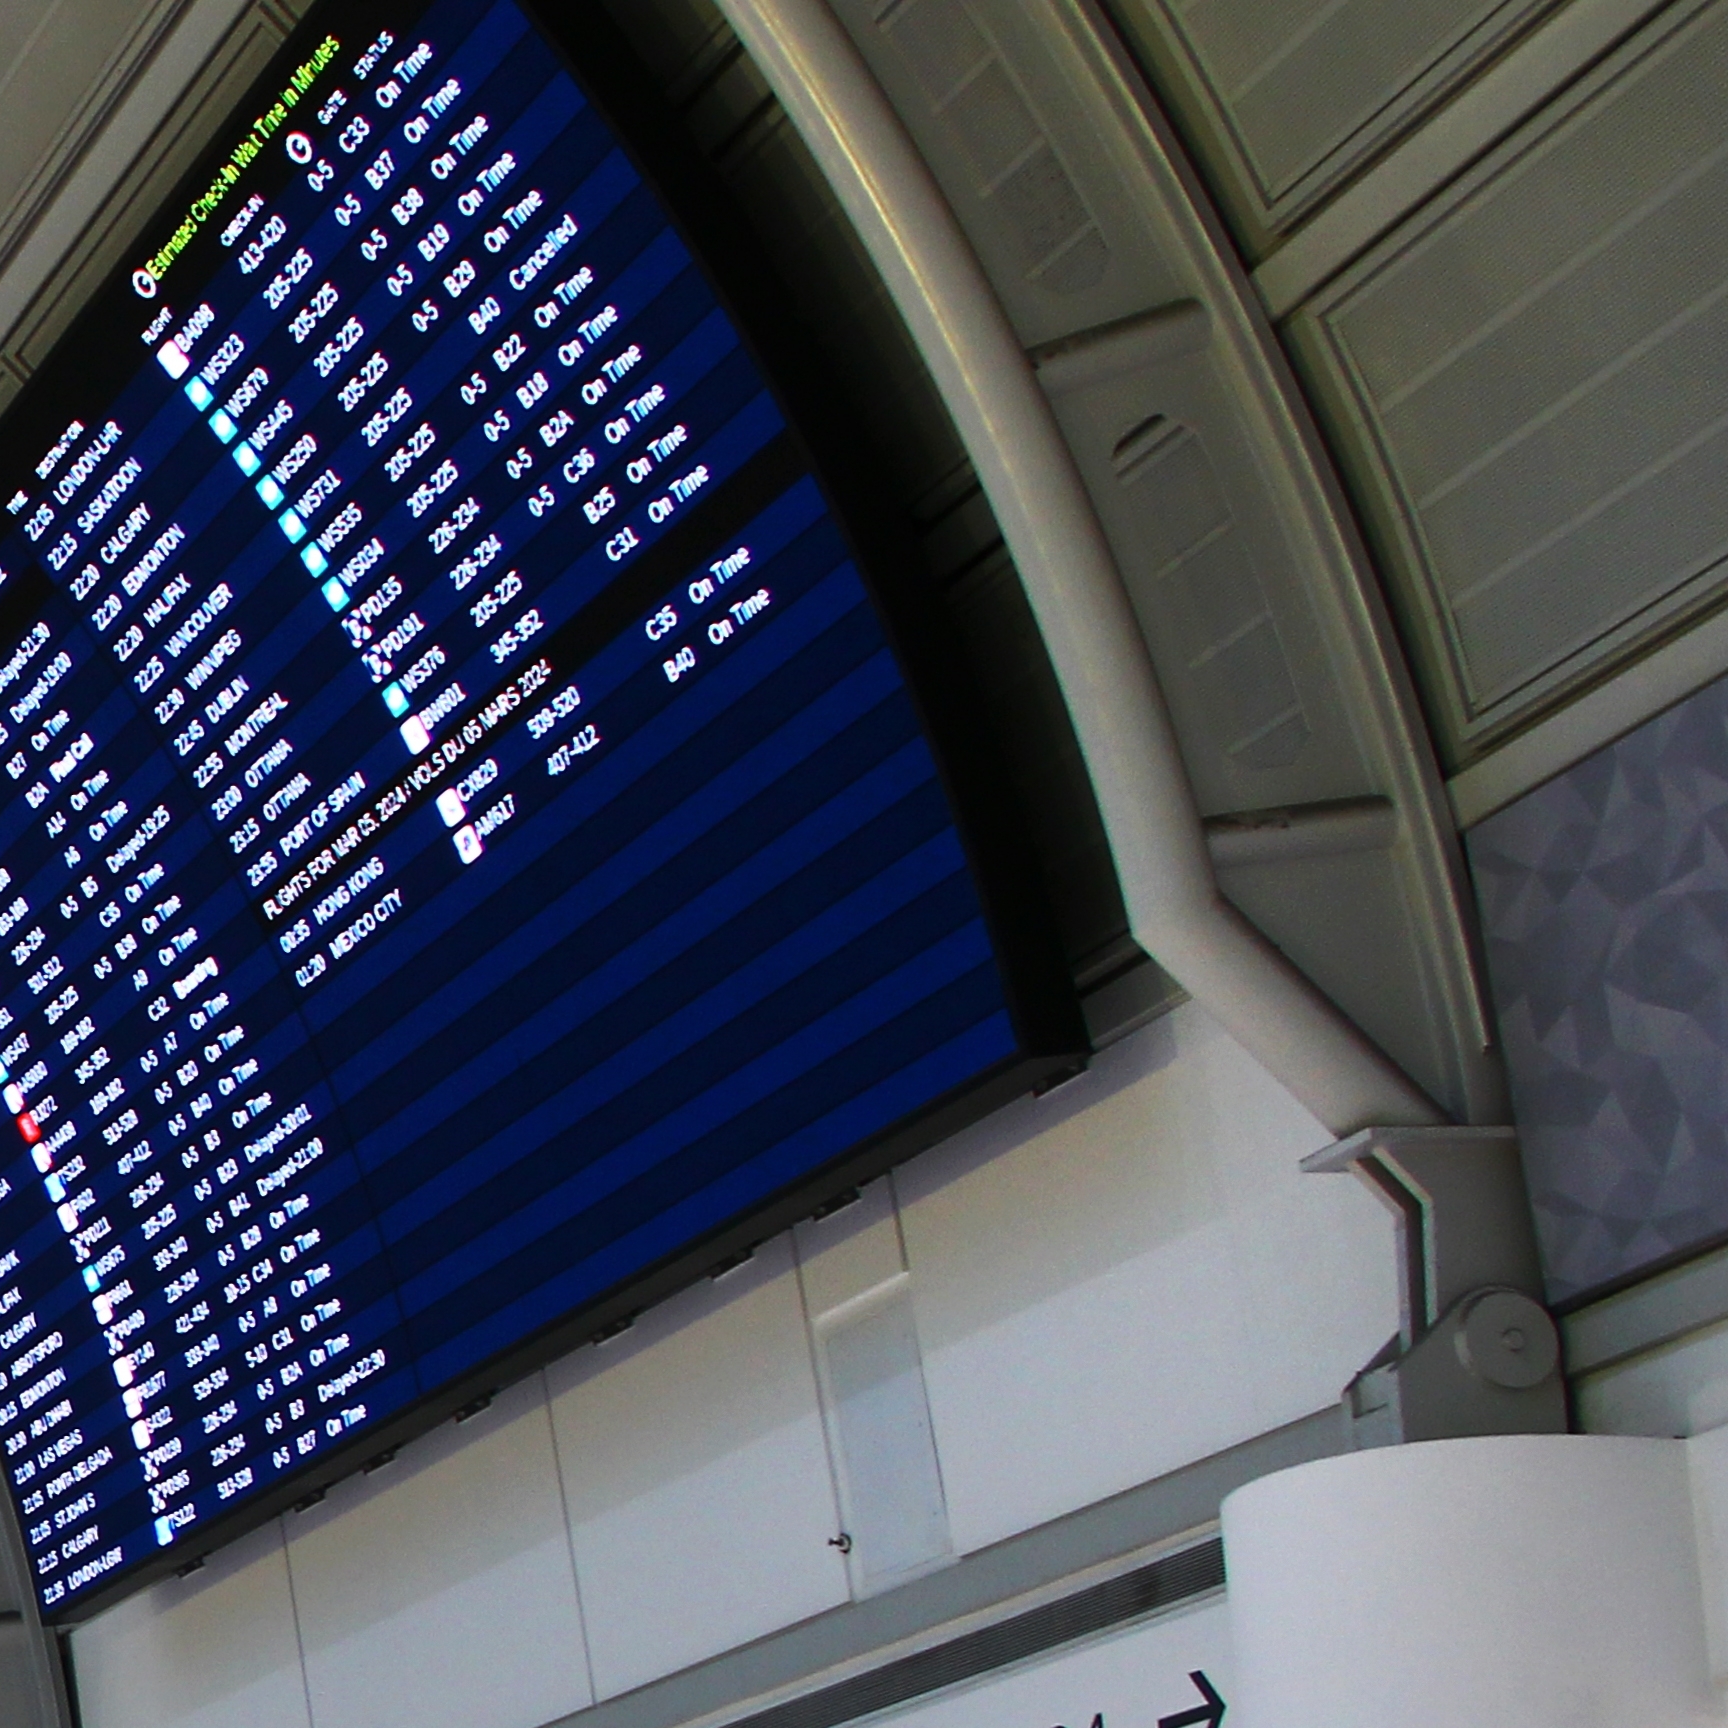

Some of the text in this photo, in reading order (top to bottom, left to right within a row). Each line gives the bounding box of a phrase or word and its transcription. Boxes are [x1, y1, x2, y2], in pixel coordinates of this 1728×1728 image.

[46, 77, 462, 571] 22:15 SASKATOON WS323 205-225 0-5 B37 On Time
[51, 419, 123, 505] LONDON-LHR
[237, 214, 287, 274] 413-420
[306, 158, 334, 192] 0-5
[337, 115, 370, 153] C33
[374, 79, 402, 108] On
[391, 42, 433, 84] Time
[68, 114, 489, 601] 22:20 CALGARY WS679 205-225 0-5 B38 On Time
[90, 151, 516, 631] 22:20 EDMONTON WS445 205-225 0-5 B19 On Time
[144, 213, 198, 281] Estimated
[189, 163, 241, 222] Check-In
[289, 34, 340, 94] Minutes
[112, 189, 543, 662] 22:20 HALIFAX WS250 205-225 0-5 B29 On Time
[133, 213, 578, 693] 22:25 VANCOUVER WS731 205-225 B40 Cancelled
[311, 884, 350, 926] HONG
[339, 855, 384, 900] KONG
[452, 757, 499, 802] CX829
[525, 684, 581, 740] 509-520
[644, 603, 678, 641] C35
[687, 576, 715, 604] On
[708, 546, 751, 584] Time
